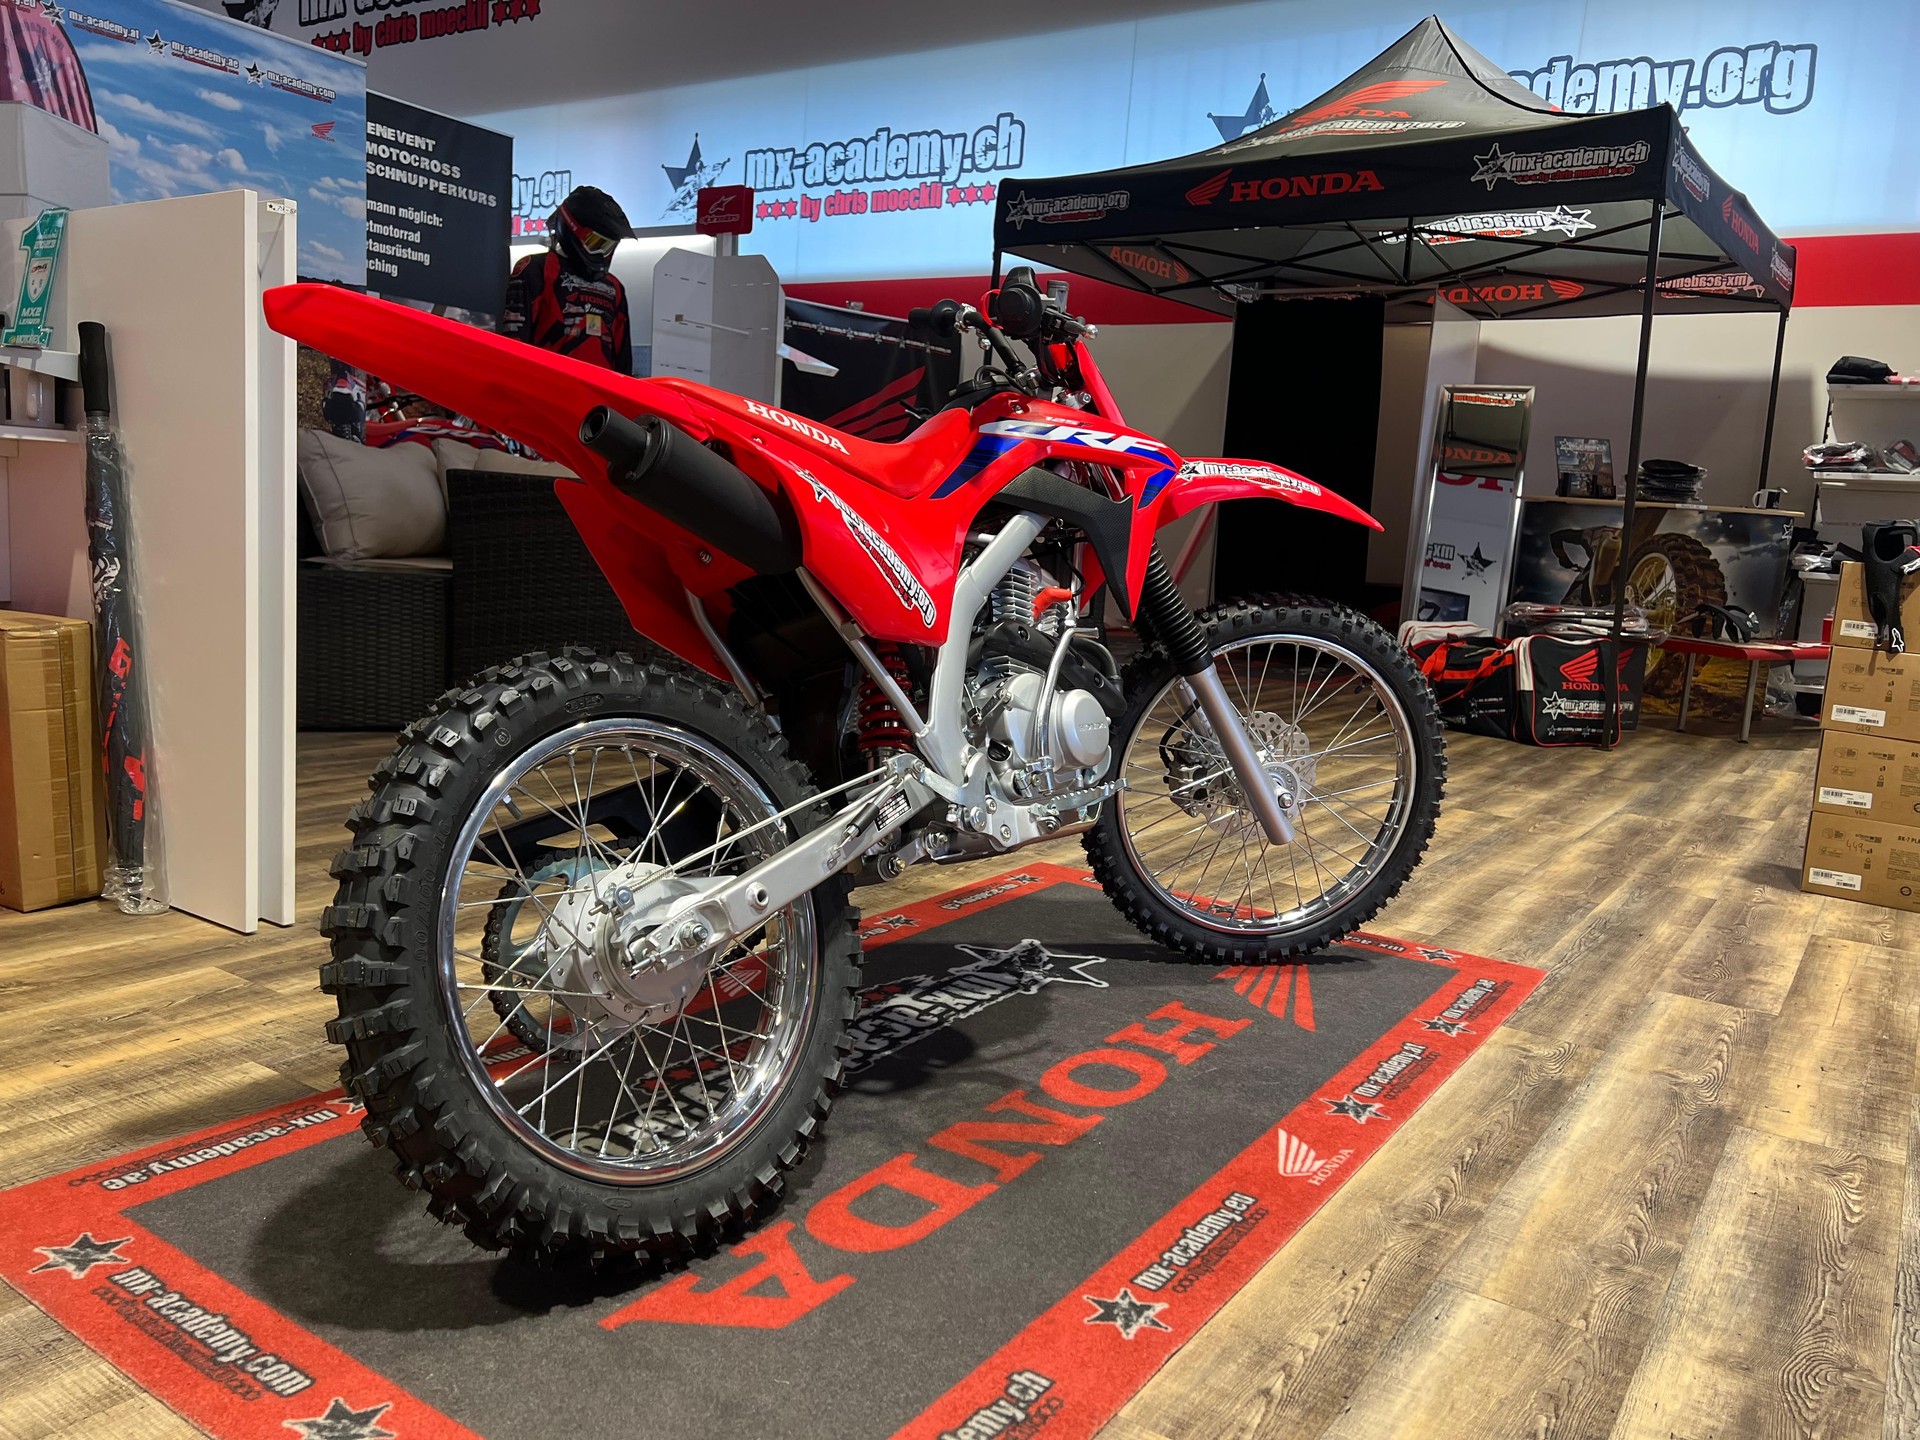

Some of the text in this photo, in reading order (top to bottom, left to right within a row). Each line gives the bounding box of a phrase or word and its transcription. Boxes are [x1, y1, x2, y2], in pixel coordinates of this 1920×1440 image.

[68, 9, 140, 40] mx-academy.at
[353, 22, 373, 56] by
[375, 12, 417, 47] chris
[420, 0, 488, 40] moeckli
[171, 40, 240, 69] mx-academy.ae
[267, 70, 336, 100] mx-academy.com
[1507, 40, 1818, 115] demy.org
[367, 121, 436, 152] ENEVENT
[745, 112, 1026, 192] mx-academy.ch
[1510, 140, 1650, 172] mx-academy.ch
[366, 141, 462, 179] MOTOCROSS
[366, 161, 498, 208] SCHNUPPERKURS
[800, 182, 943, 222] by chris moeckli
[1032, 190, 1129, 215] mx-academy.org
[1229, 170, 1385, 202] HONDA
[399, 206, 444, 227] möglich:
[1731, 211, 1760, 255] HONDA
[366, 258, 398, 277] ching
[744, 399, 850, 455] HONDA
[979, 419, 1167, 452] CRF
[101, 1109, 340, 1192] mx-academy.ae
[599, 1000, 1253, 1331] HONDA
[1308, 1147, 1354, 1187] HONDA
[1130, 1191, 1259, 1292] mx-academy.eu
[106, 1265, 316, 1397] mx-academy.com
